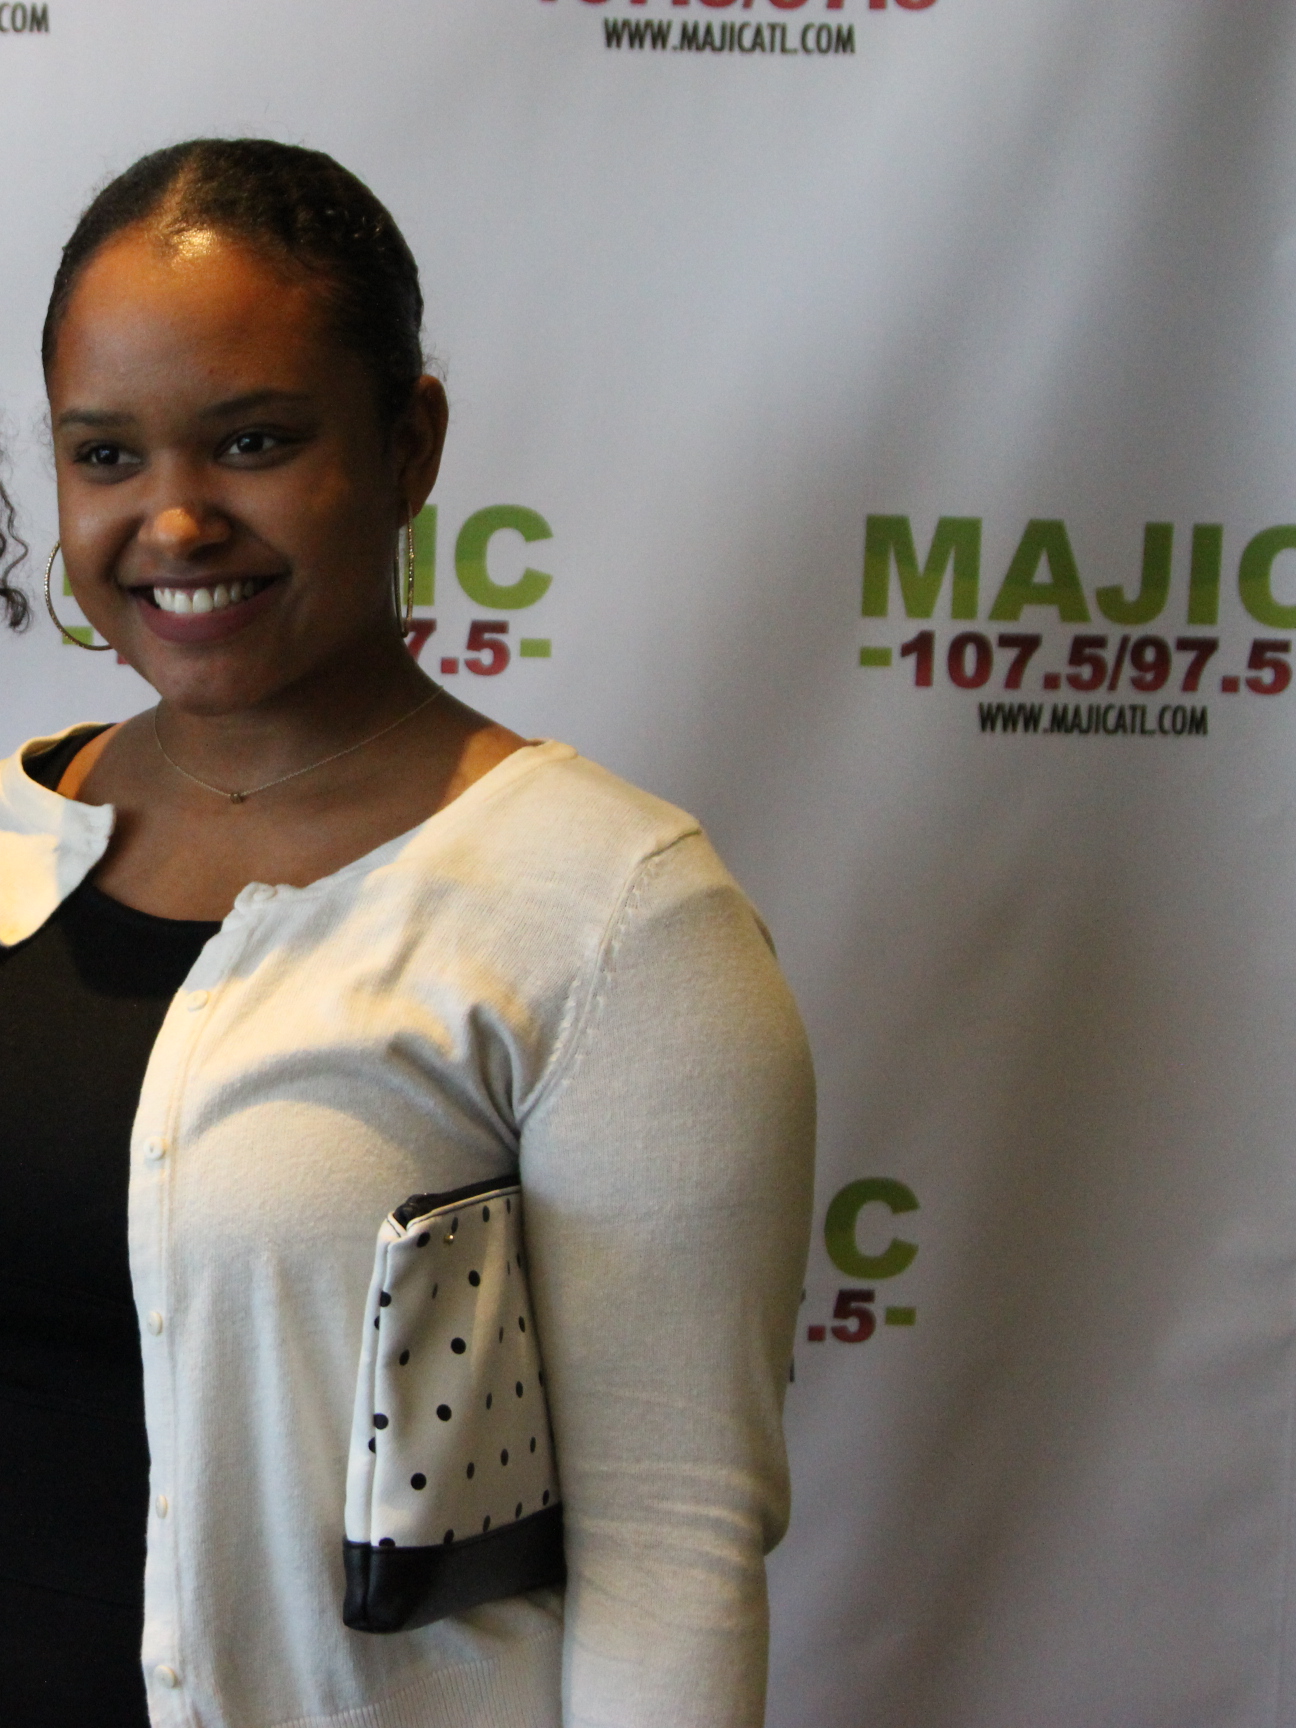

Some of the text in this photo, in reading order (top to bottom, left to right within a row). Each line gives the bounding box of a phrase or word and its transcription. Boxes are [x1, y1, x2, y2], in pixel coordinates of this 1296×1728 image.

[603, 17, 857, 55] WWW.MAJICATL.COM
[861, 513, 1296, 630] MAJIC
[978, 701, 1209, 736] WWW.MAJICATL.COM
